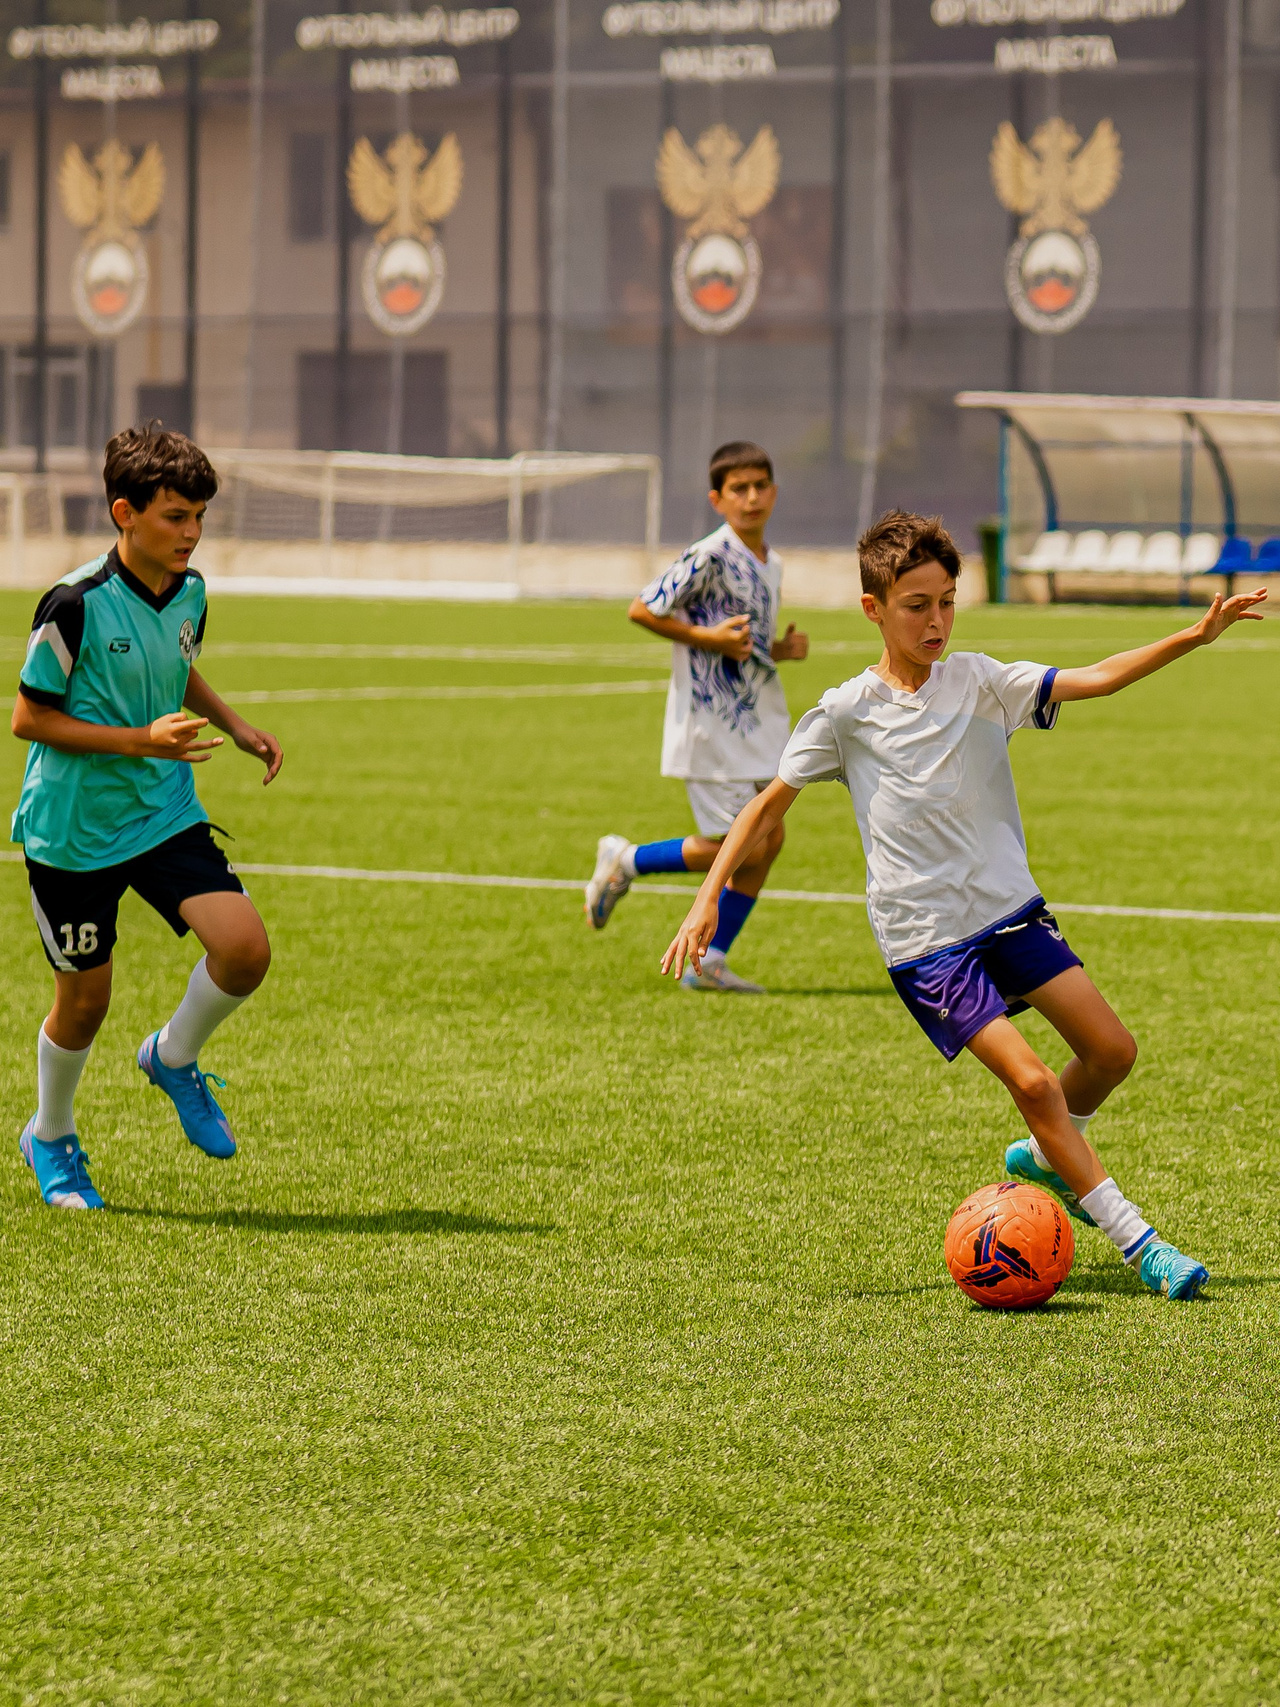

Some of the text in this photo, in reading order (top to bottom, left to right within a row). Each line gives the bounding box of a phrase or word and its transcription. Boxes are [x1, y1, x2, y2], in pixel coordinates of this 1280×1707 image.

[349, 54, 461, 94] МАЦЕСТА
[660, 43, 777, 84] МАЦЕСТА
[994, 34, 1118, 75] МАЦЕСТА
[60, 64, 165, 101] МАЦЕСТА
[60, 922, 99, 957] 18
[1049, 1201, 1062, 1262] DEMIX
